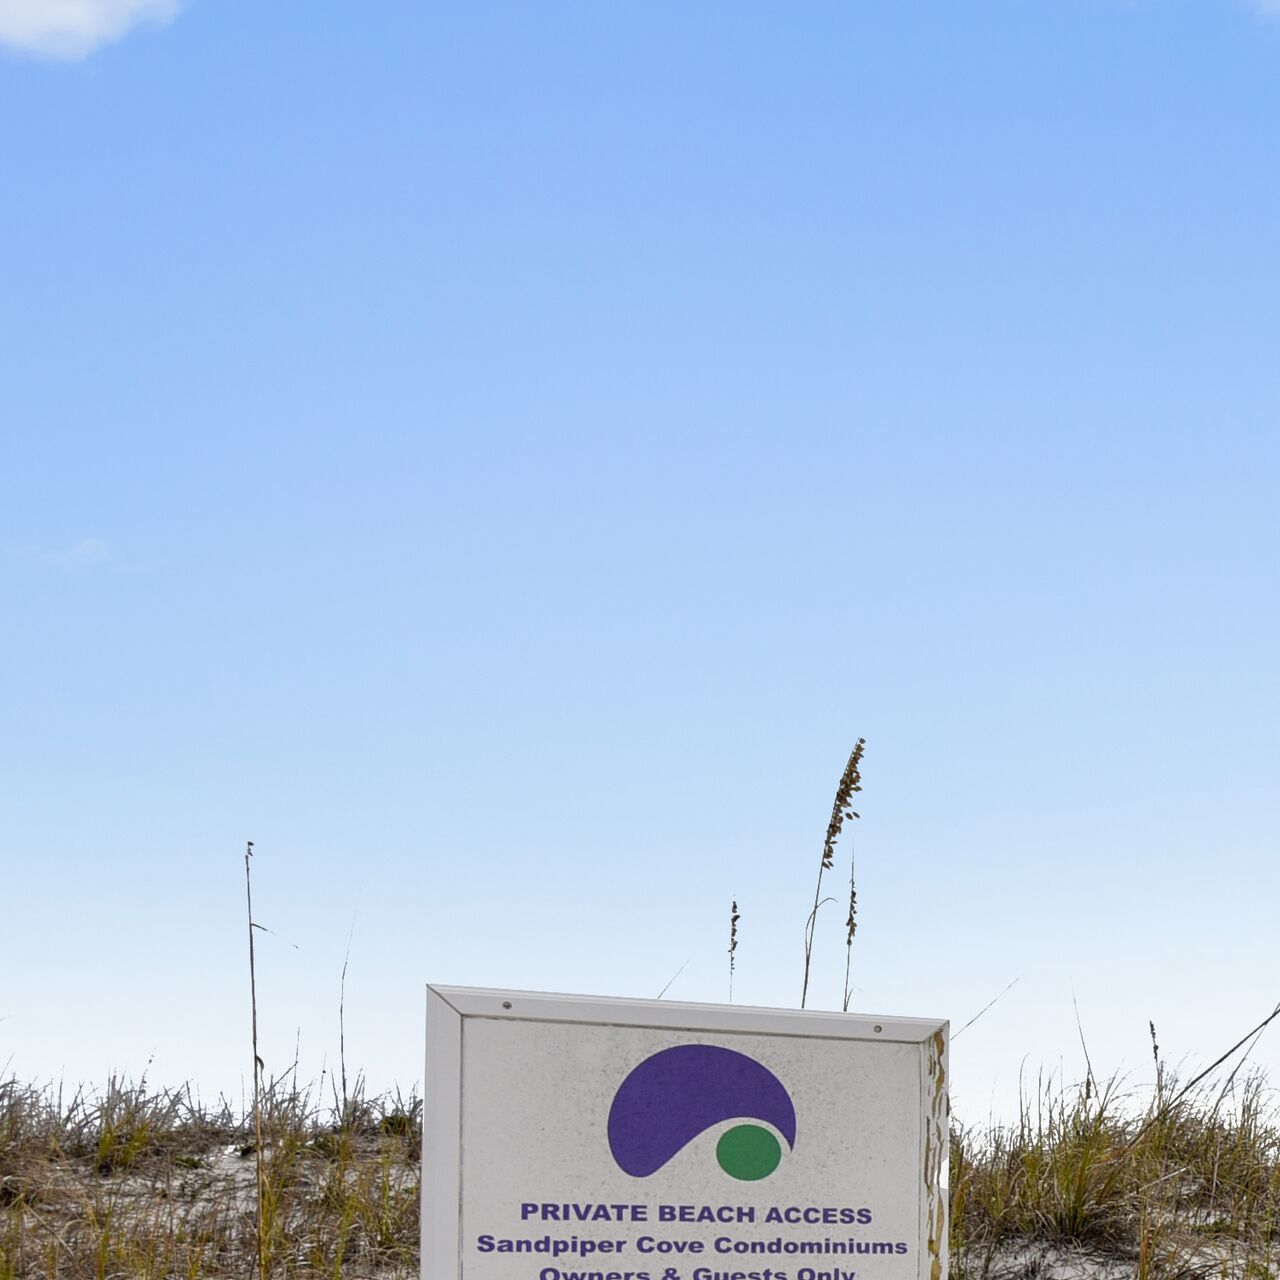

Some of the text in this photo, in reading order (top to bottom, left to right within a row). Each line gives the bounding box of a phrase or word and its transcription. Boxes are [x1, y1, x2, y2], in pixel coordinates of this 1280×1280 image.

[520, 1202, 873, 1225] PRIVATE BEACH ACCESS
[476, 1234, 909, 1258] Sandpiper Cove Condominiums
